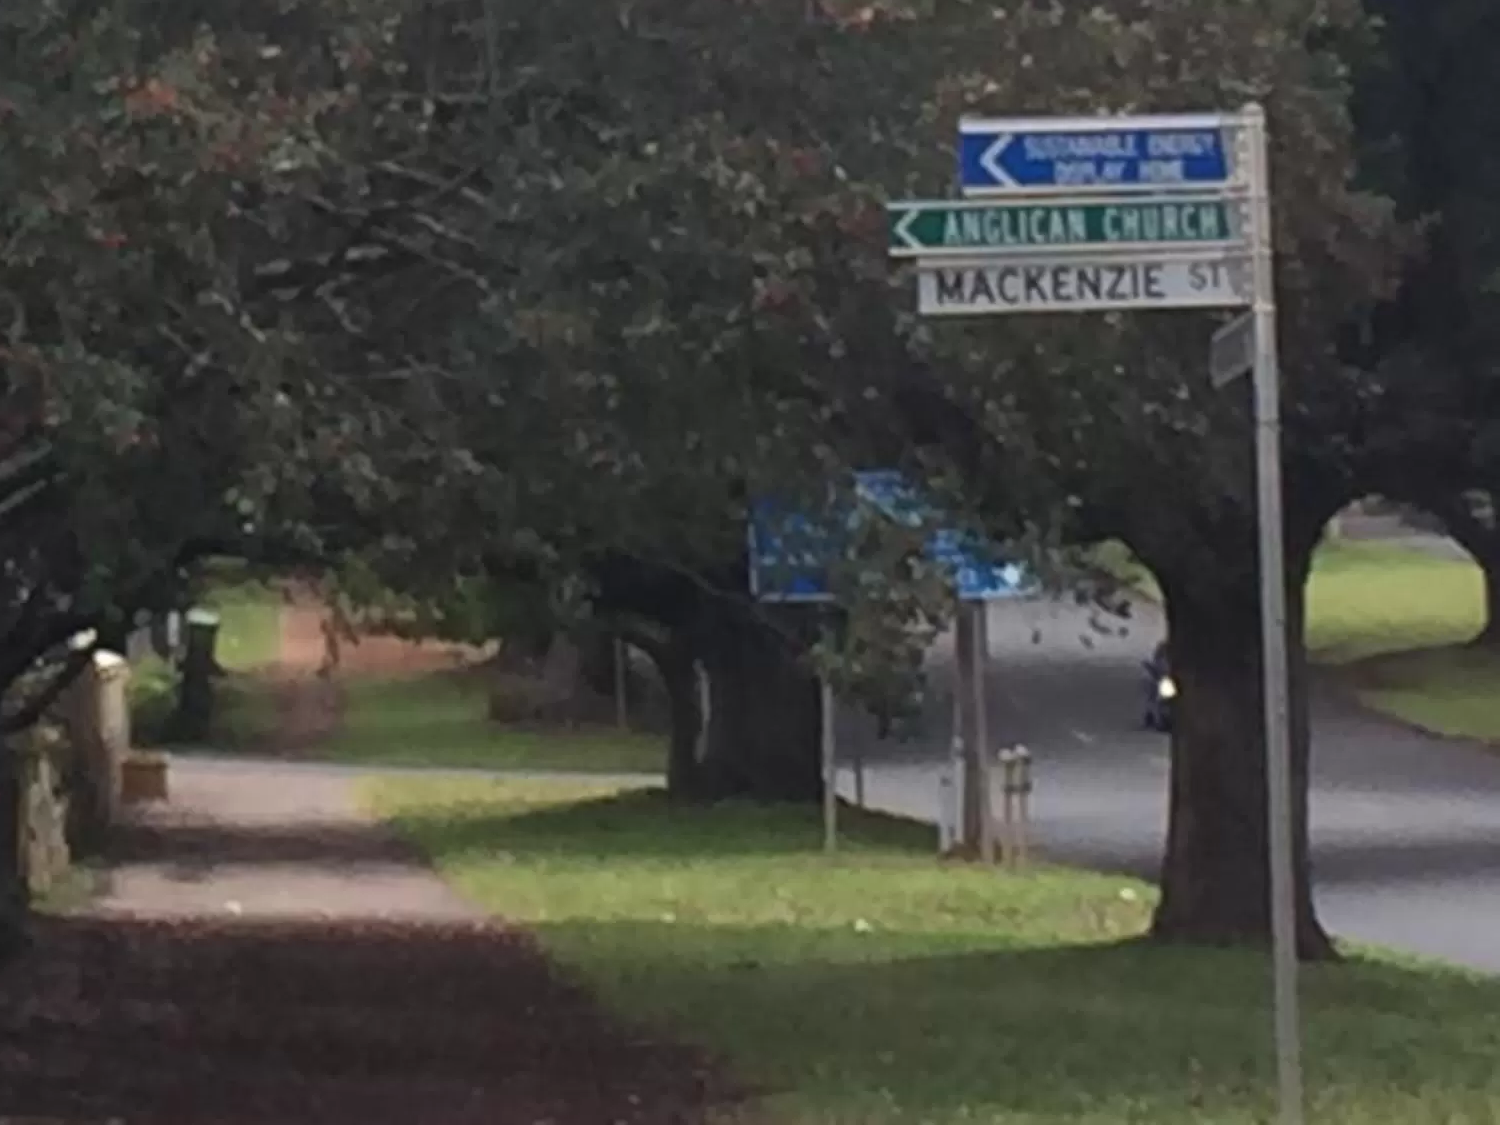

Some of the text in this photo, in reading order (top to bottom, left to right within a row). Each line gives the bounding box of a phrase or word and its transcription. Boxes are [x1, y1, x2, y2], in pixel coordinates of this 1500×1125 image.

[943, 204, 1219, 245] ANGLICAN CHURCH
[936, 265, 1222, 304] MACKENZIE ST
